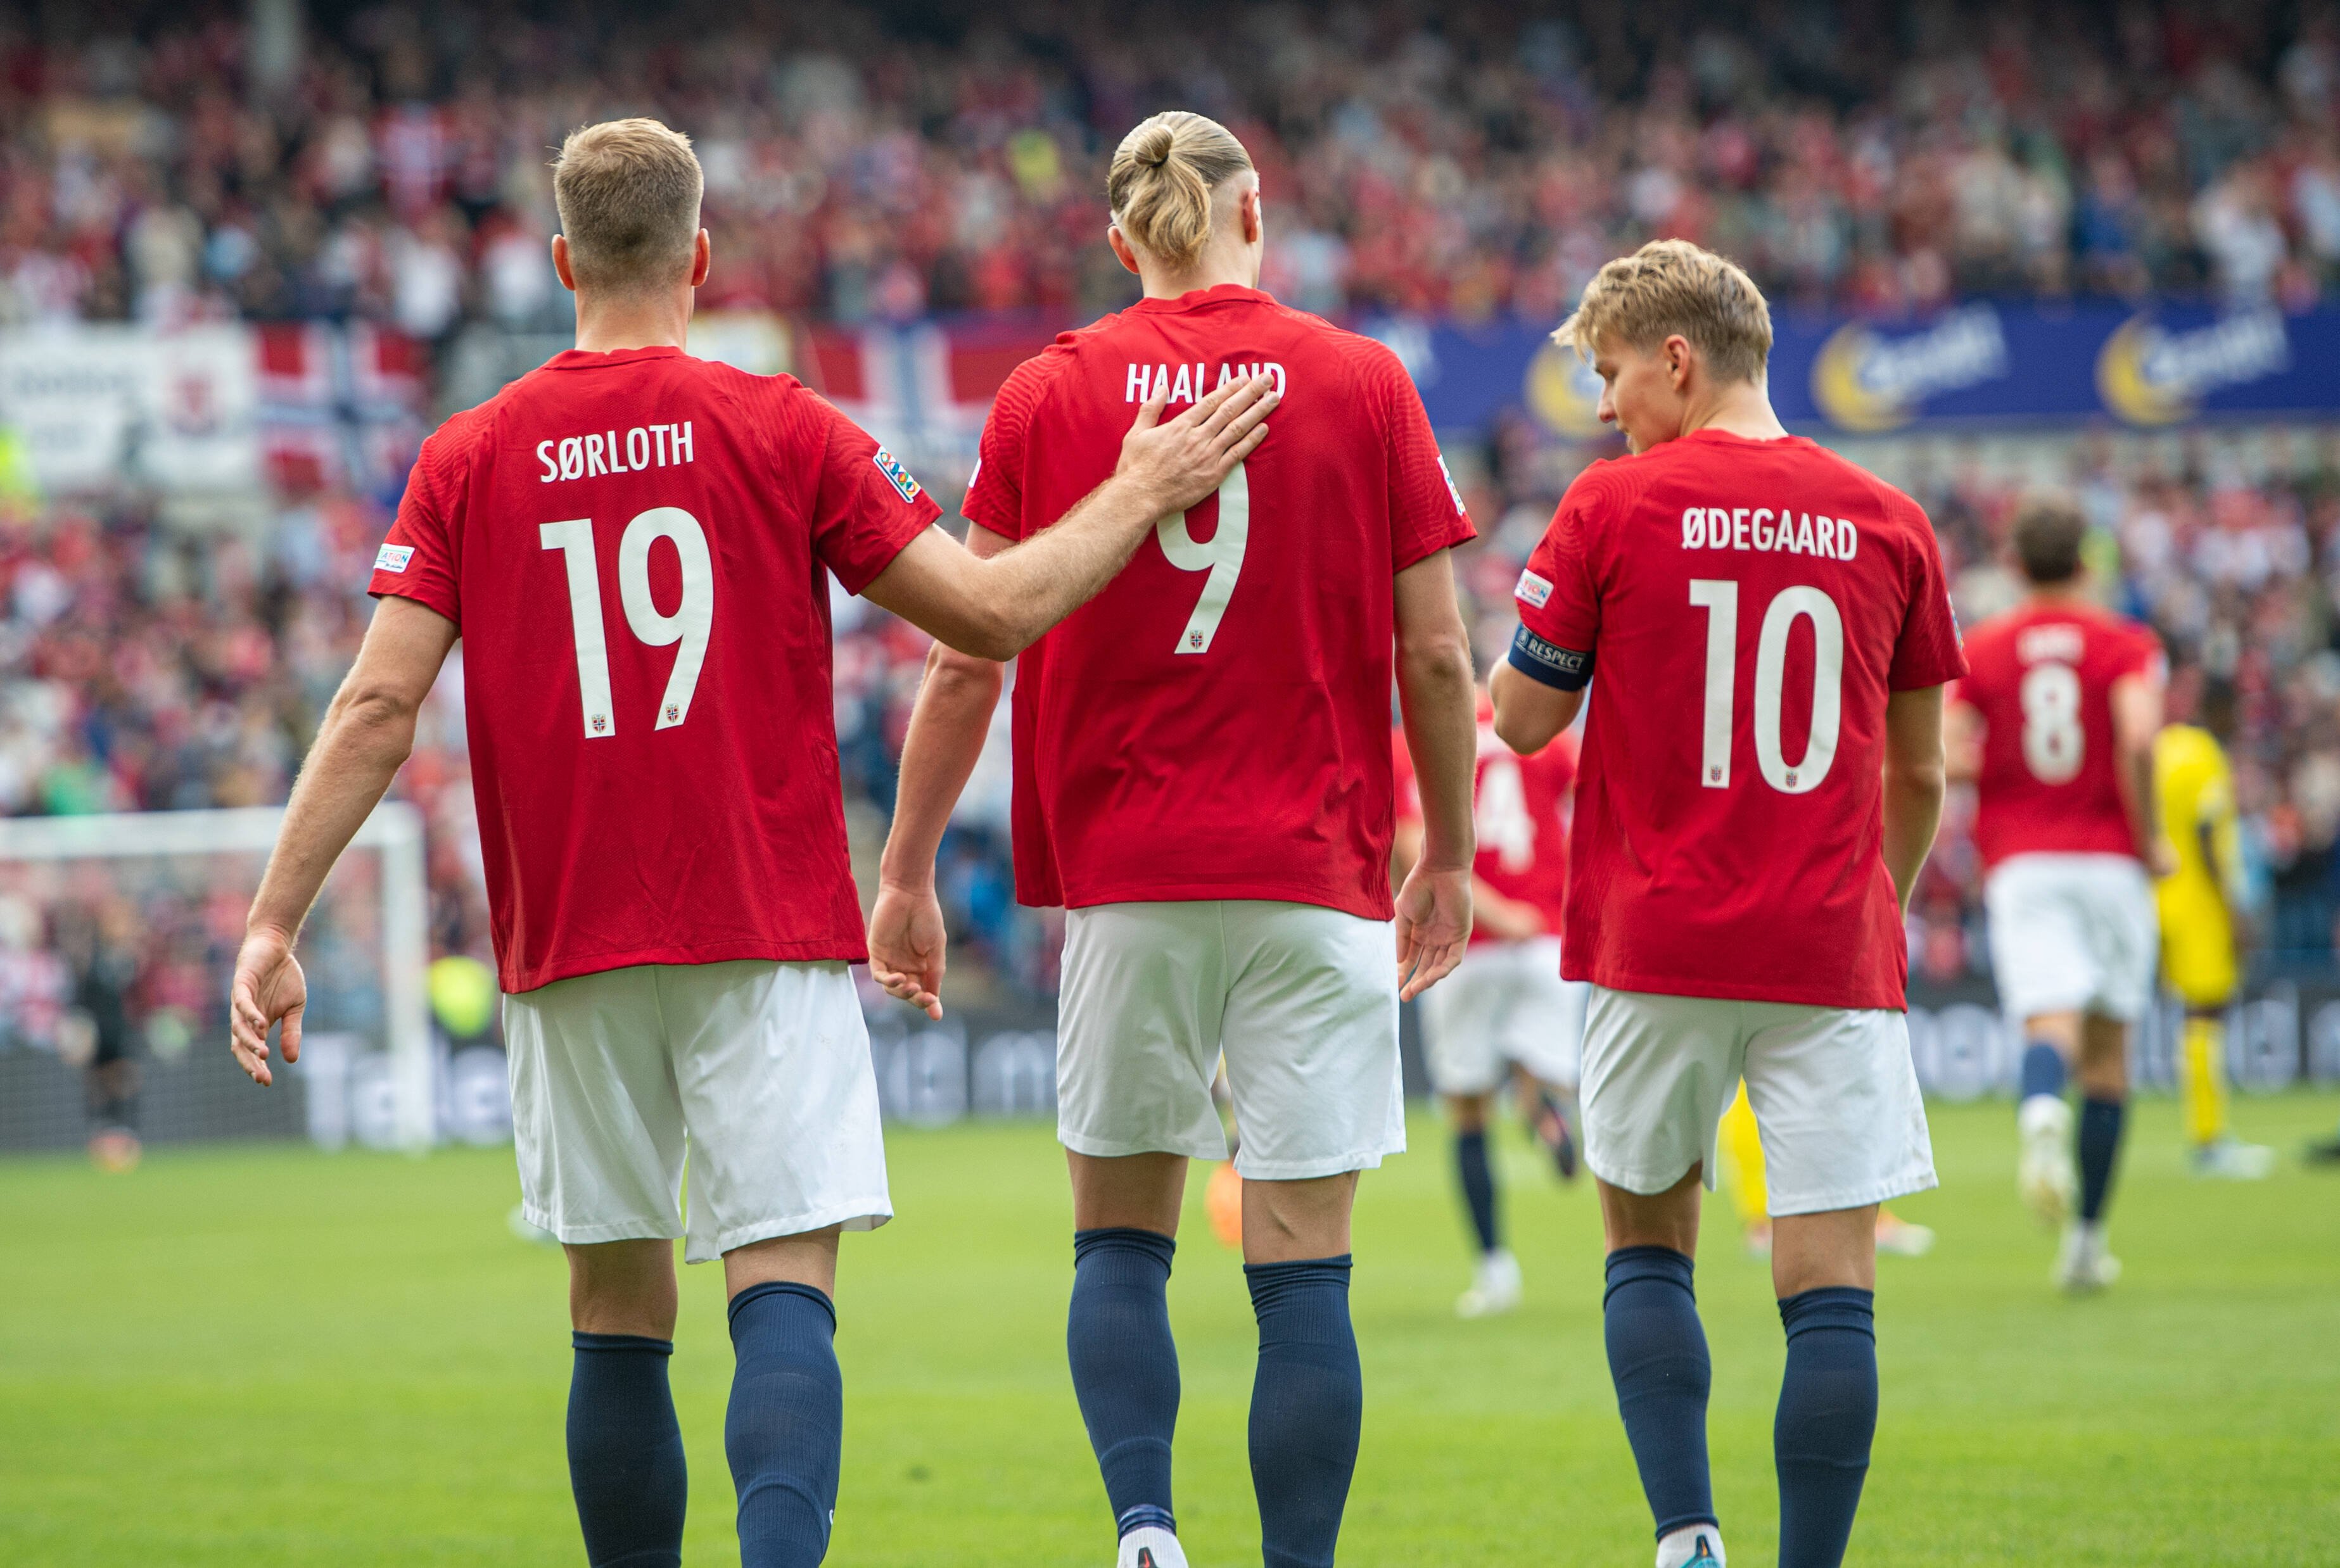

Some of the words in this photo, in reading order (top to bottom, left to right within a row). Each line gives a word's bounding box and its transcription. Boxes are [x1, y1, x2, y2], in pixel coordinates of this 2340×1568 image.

[536, 420, 694, 483] SØRLOTH
[1156, 461, 1250, 655] 9
[1681, 507, 1857, 561] ØDEGAARD
[539, 506, 715, 740] 19
[1528, 637, 1584, 669] RESPECT
[1689, 579, 1844, 794] 10
[2020, 663, 2085, 784] 8
